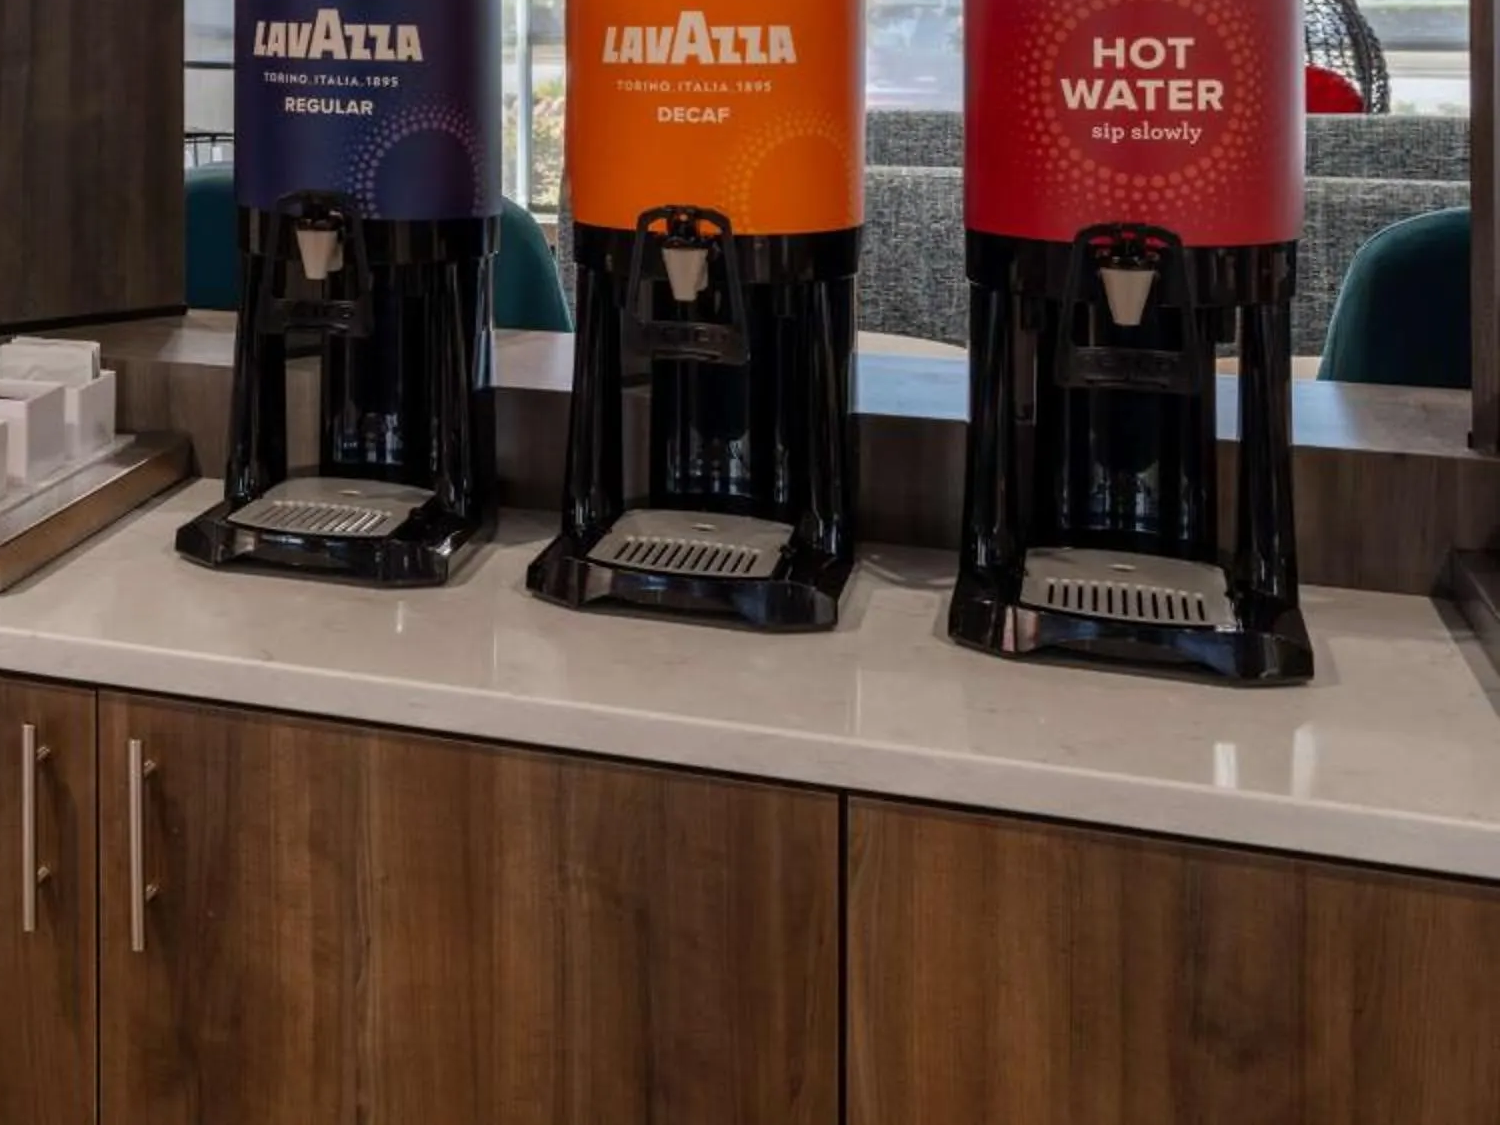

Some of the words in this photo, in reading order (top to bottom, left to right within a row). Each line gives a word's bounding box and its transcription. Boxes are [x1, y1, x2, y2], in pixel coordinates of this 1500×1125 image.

[253, 8, 423, 62] LAVAZZA
[602, 10, 797, 65] LAVAZZA
[1093, 37, 1195, 70] HOT
[284, 96, 373, 116] REGULAR
[1060, 78, 1224, 111] WATER
[657, 106, 731, 124] DECAF
[1091, 122, 1125, 144] sip
[1131, 120, 1202, 144] slowly
